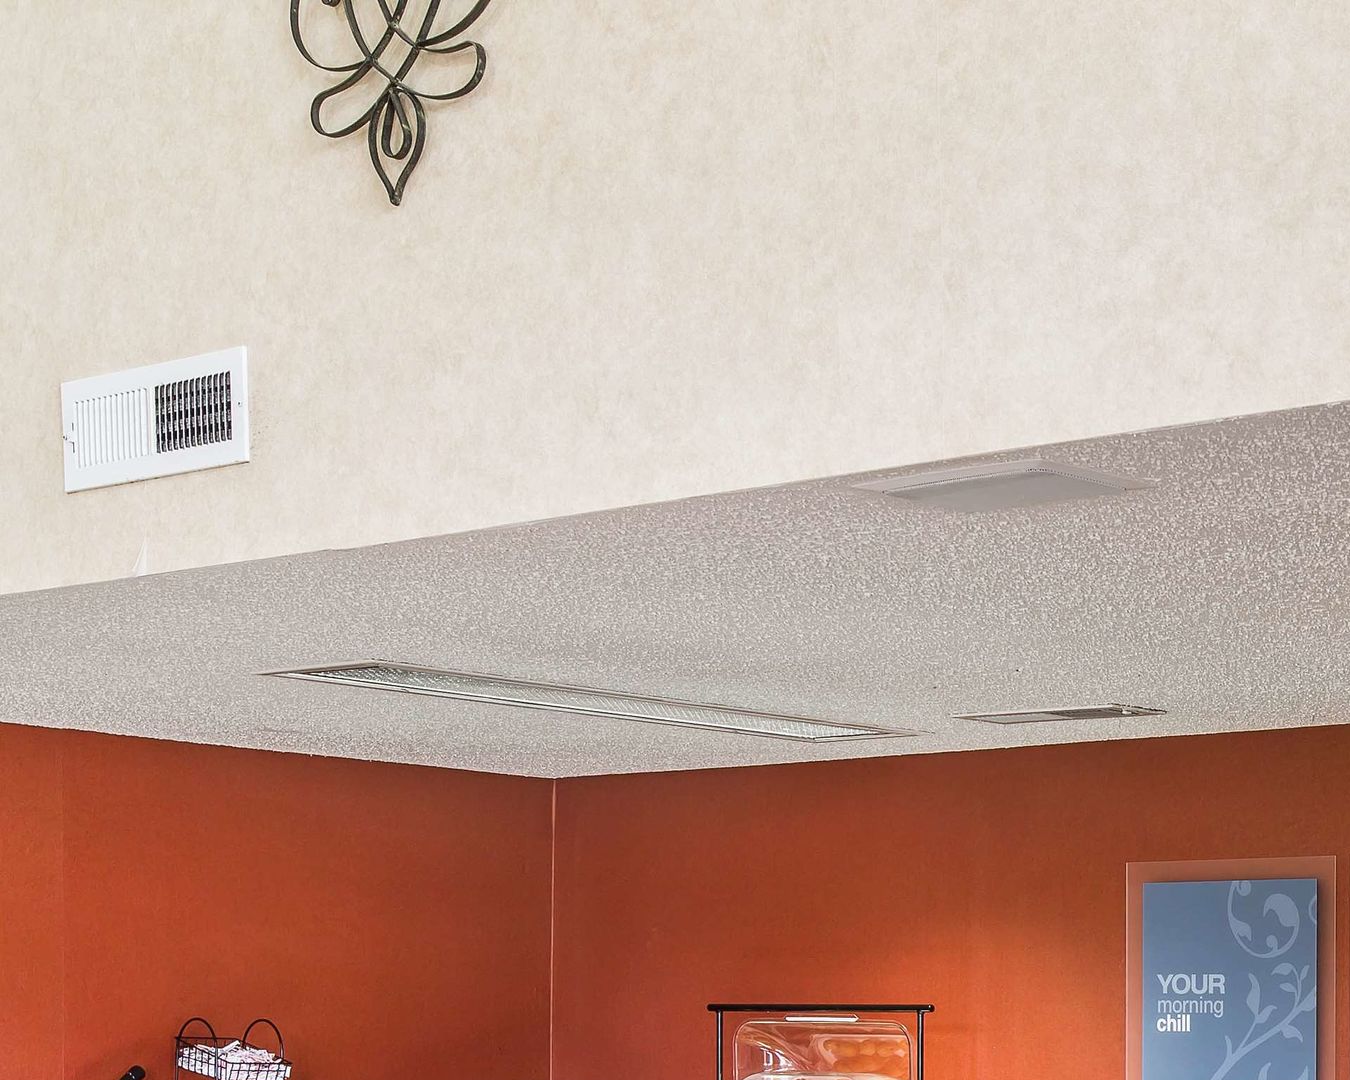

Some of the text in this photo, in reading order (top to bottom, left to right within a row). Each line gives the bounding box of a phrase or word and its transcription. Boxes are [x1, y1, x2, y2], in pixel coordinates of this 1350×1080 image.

[1156, 973, 1226, 995] YOUR
[1157, 996, 1224, 1018] morning
[1156, 1013, 1191, 1032] chill
